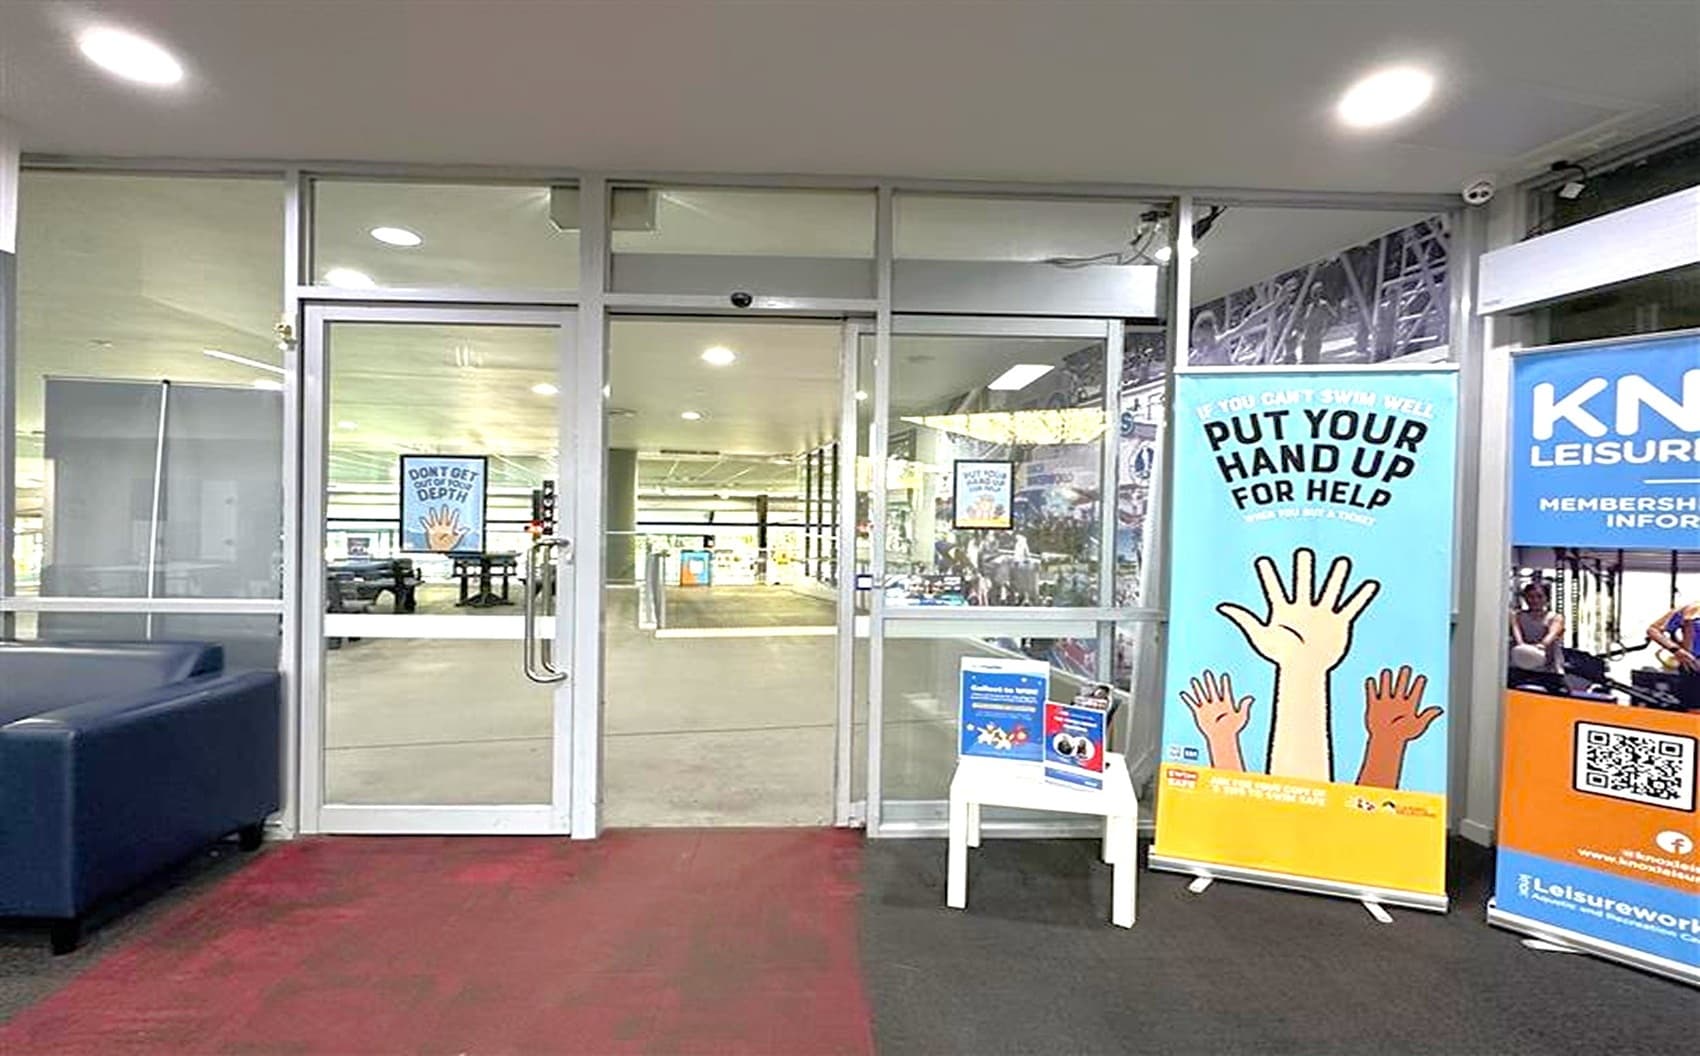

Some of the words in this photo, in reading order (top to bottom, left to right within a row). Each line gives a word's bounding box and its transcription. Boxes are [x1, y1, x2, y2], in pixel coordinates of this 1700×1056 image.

[1197, 402, 1216, 420] IF
[1218, 395, 1256, 413] YOU
[1261, 389, 1315, 407] CAN'T
[1321, 389, 1377, 408] SWIM
[1384, 397, 1434, 419] WELL
[1203, 410, 1290, 451] PUT
[1304, 409, 1429, 453] YOUR
[1216, 444, 1340, 483] HAND
[1351, 446, 1416, 483] UP
[1531, 439, 1700, 467] LEISUR
[414, 479, 434, 488] OUT
[435, 479, 445, 487] OF
[451, 467, 479, 481] GET
[417, 488, 468, 503] DEPTH
[1231, 480, 1294, 510] FOR
[1307, 479, 1392, 510] HELP
[1607, 514, 1700, 528] INFOR
[1579, 906, 1603, 919] and
